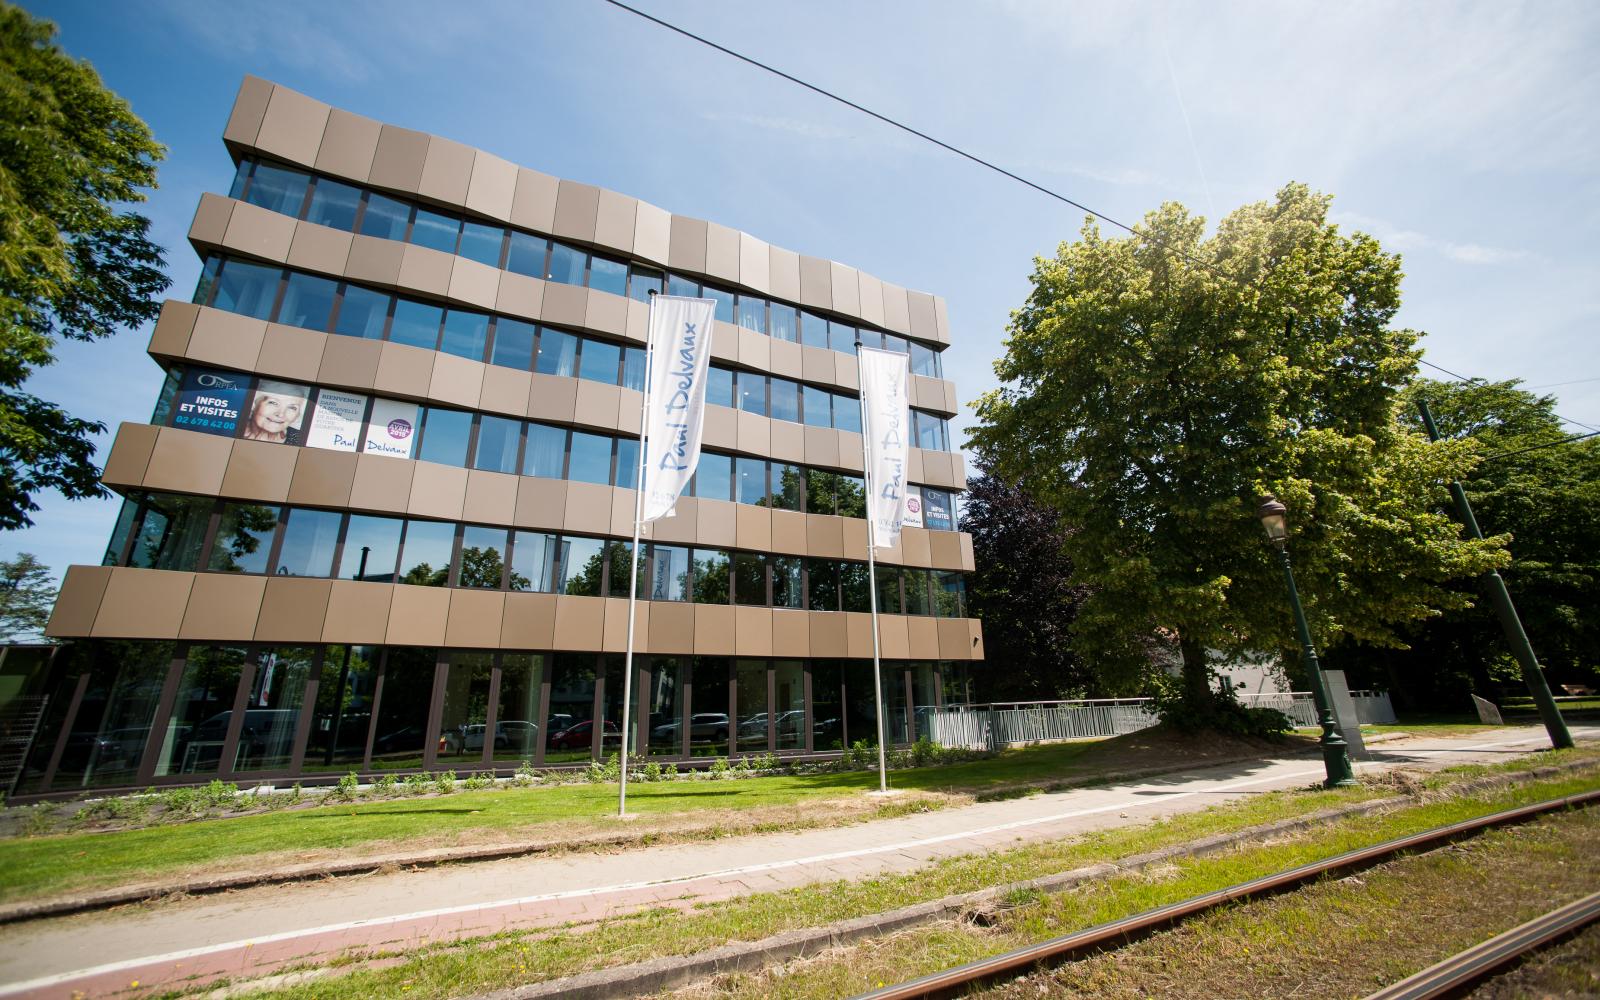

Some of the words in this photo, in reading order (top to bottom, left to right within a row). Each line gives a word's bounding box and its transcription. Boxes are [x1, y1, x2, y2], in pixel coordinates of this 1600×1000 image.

[665, 321, 697, 415] Delvaux
[197, 374, 238, 391] ORPEA
[180, 403, 196, 412] ET
[197, 405, 238, 419] VISITES
[196, 395, 229, 408] INFOS
[176, 415, 189, 424] 02
[190, 417, 209, 427] 678
[210, 419, 223, 428] 42
[224, 421, 236, 430] 00
[333, 434, 356, 447] Paul
[367, 440, 408, 455] Delvaux
[659, 423, 688, 471] Paul
[881, 457, 902, 501] Paul
